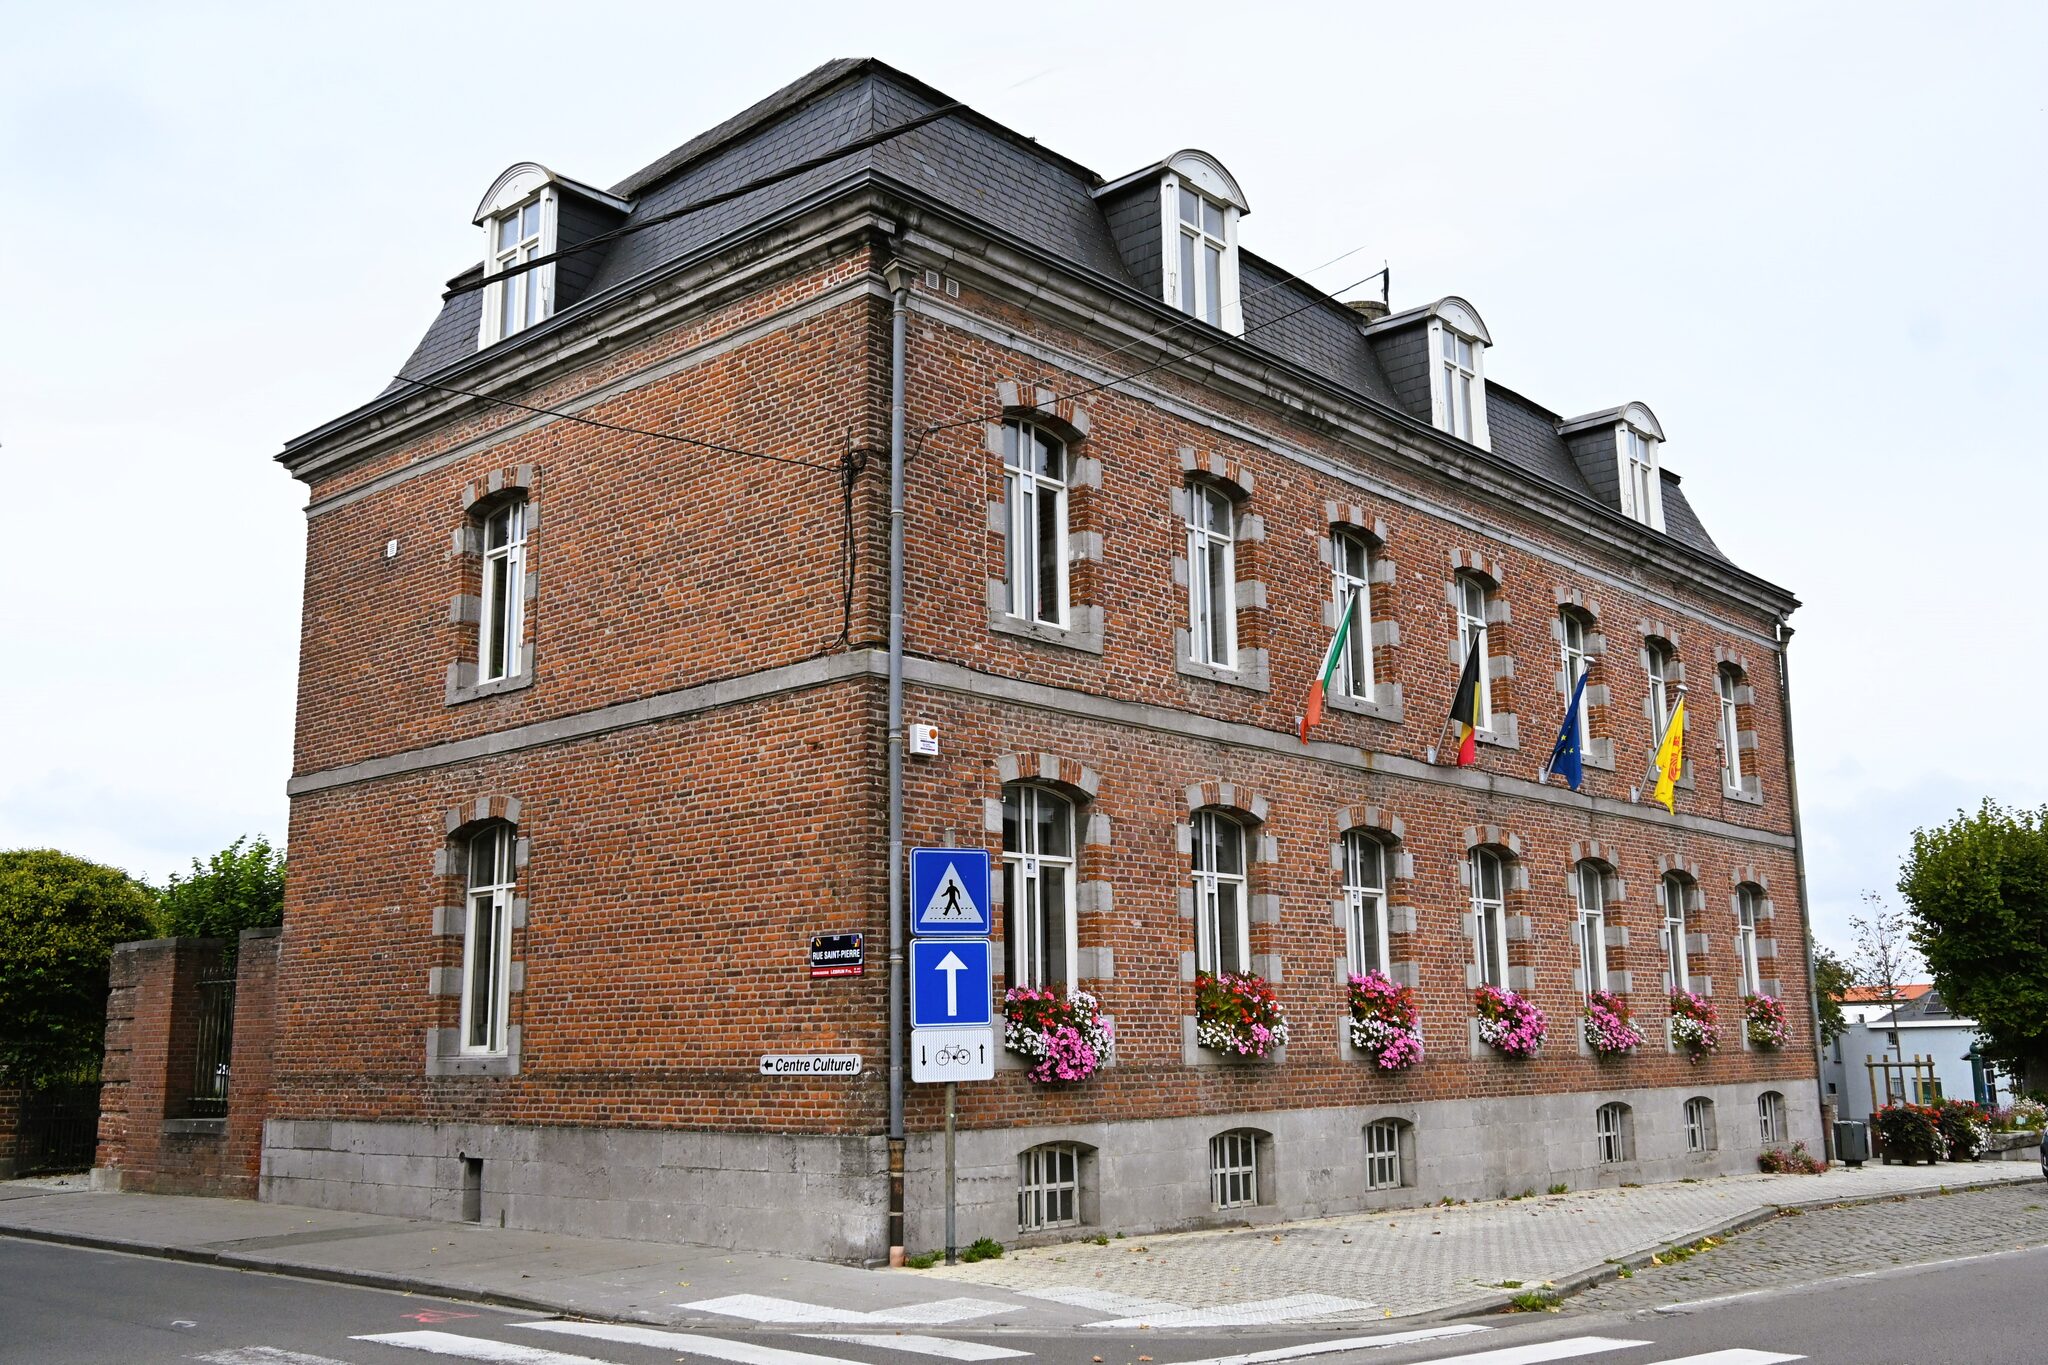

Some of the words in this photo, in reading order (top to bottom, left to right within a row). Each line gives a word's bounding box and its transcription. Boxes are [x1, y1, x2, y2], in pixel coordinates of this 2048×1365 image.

[813, 951, 823, 960] RUE
[824, 949, 860, 959] SAINT-PIERRE
[775, 1058, 811, 1072] Centre
[813, 1058, 856, 1072] Culturel
